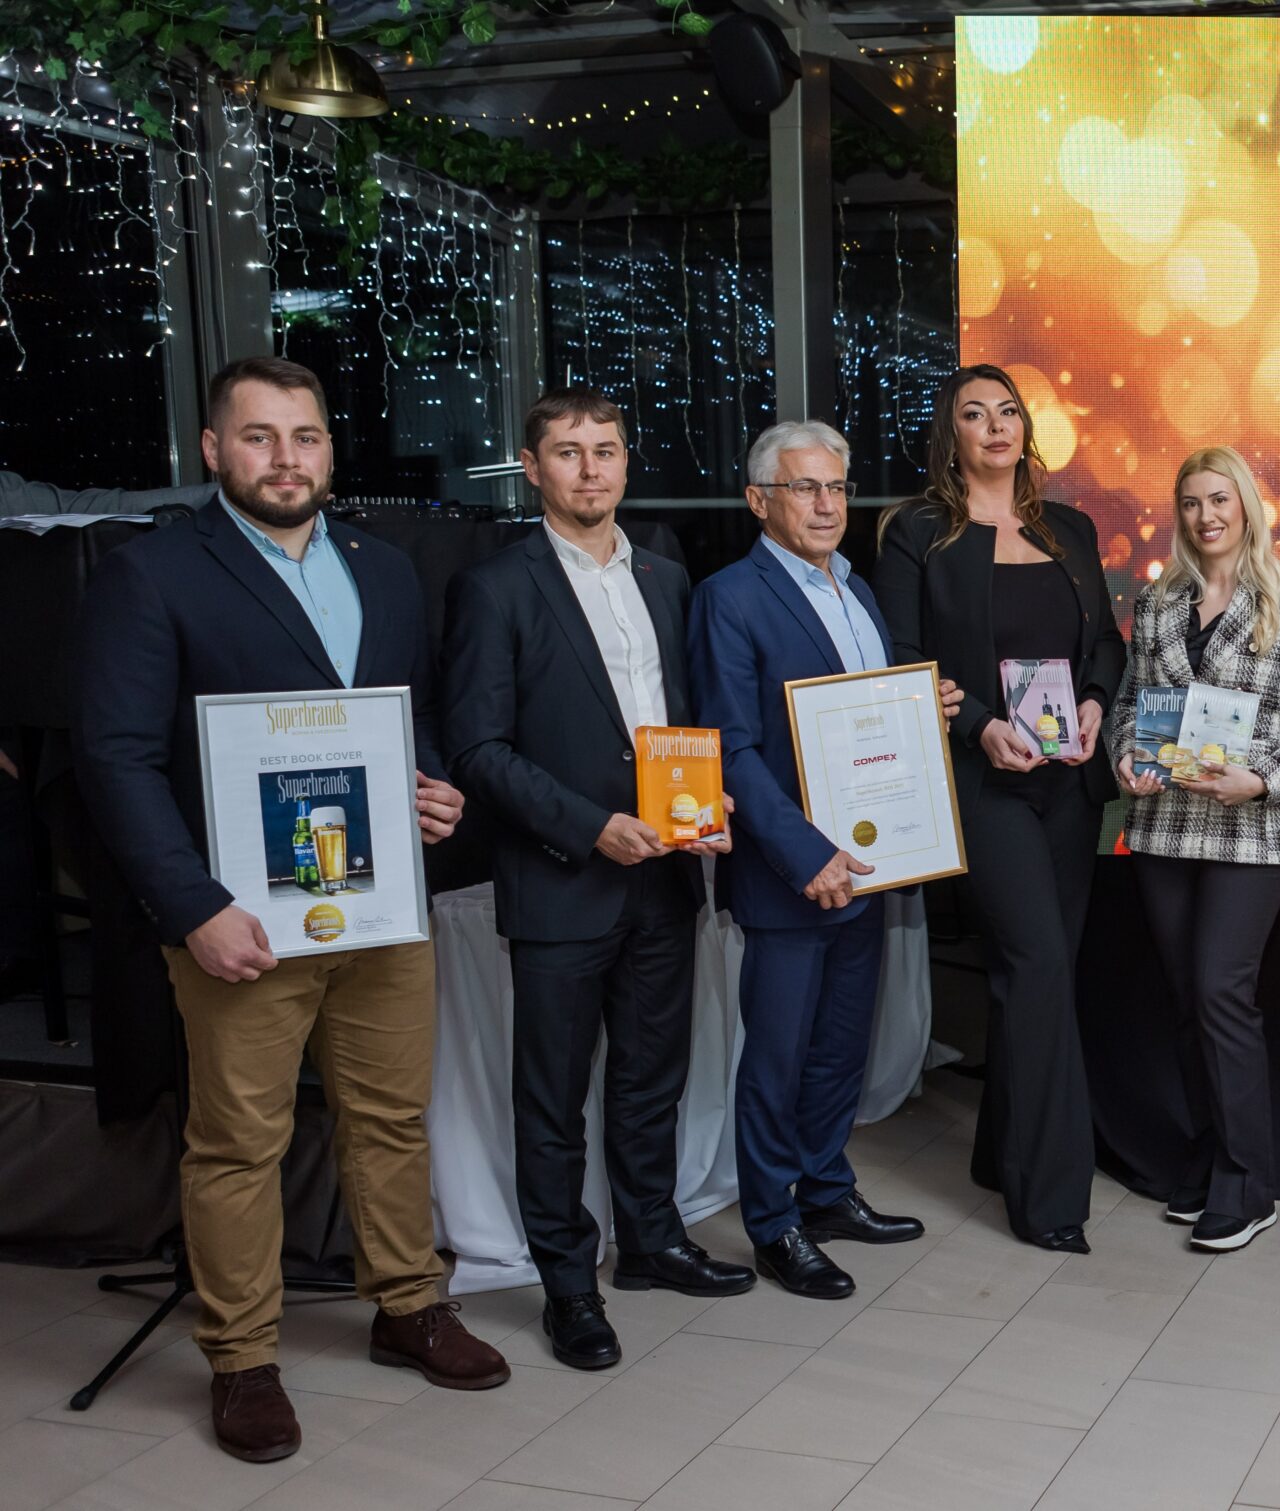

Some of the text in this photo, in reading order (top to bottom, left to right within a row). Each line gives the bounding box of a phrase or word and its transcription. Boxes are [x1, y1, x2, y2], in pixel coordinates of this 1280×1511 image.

[266, 699, 347, 735] Superbrands
[1140, 689, 1187, 716] Superbra
[260, 751, 362, 766] BEST BOOK COVER
[646, 730, 719, 761] Superbrands
[853, 753, 897, 766] COMPEX
[277, 770, 351, 804] Superbrands
